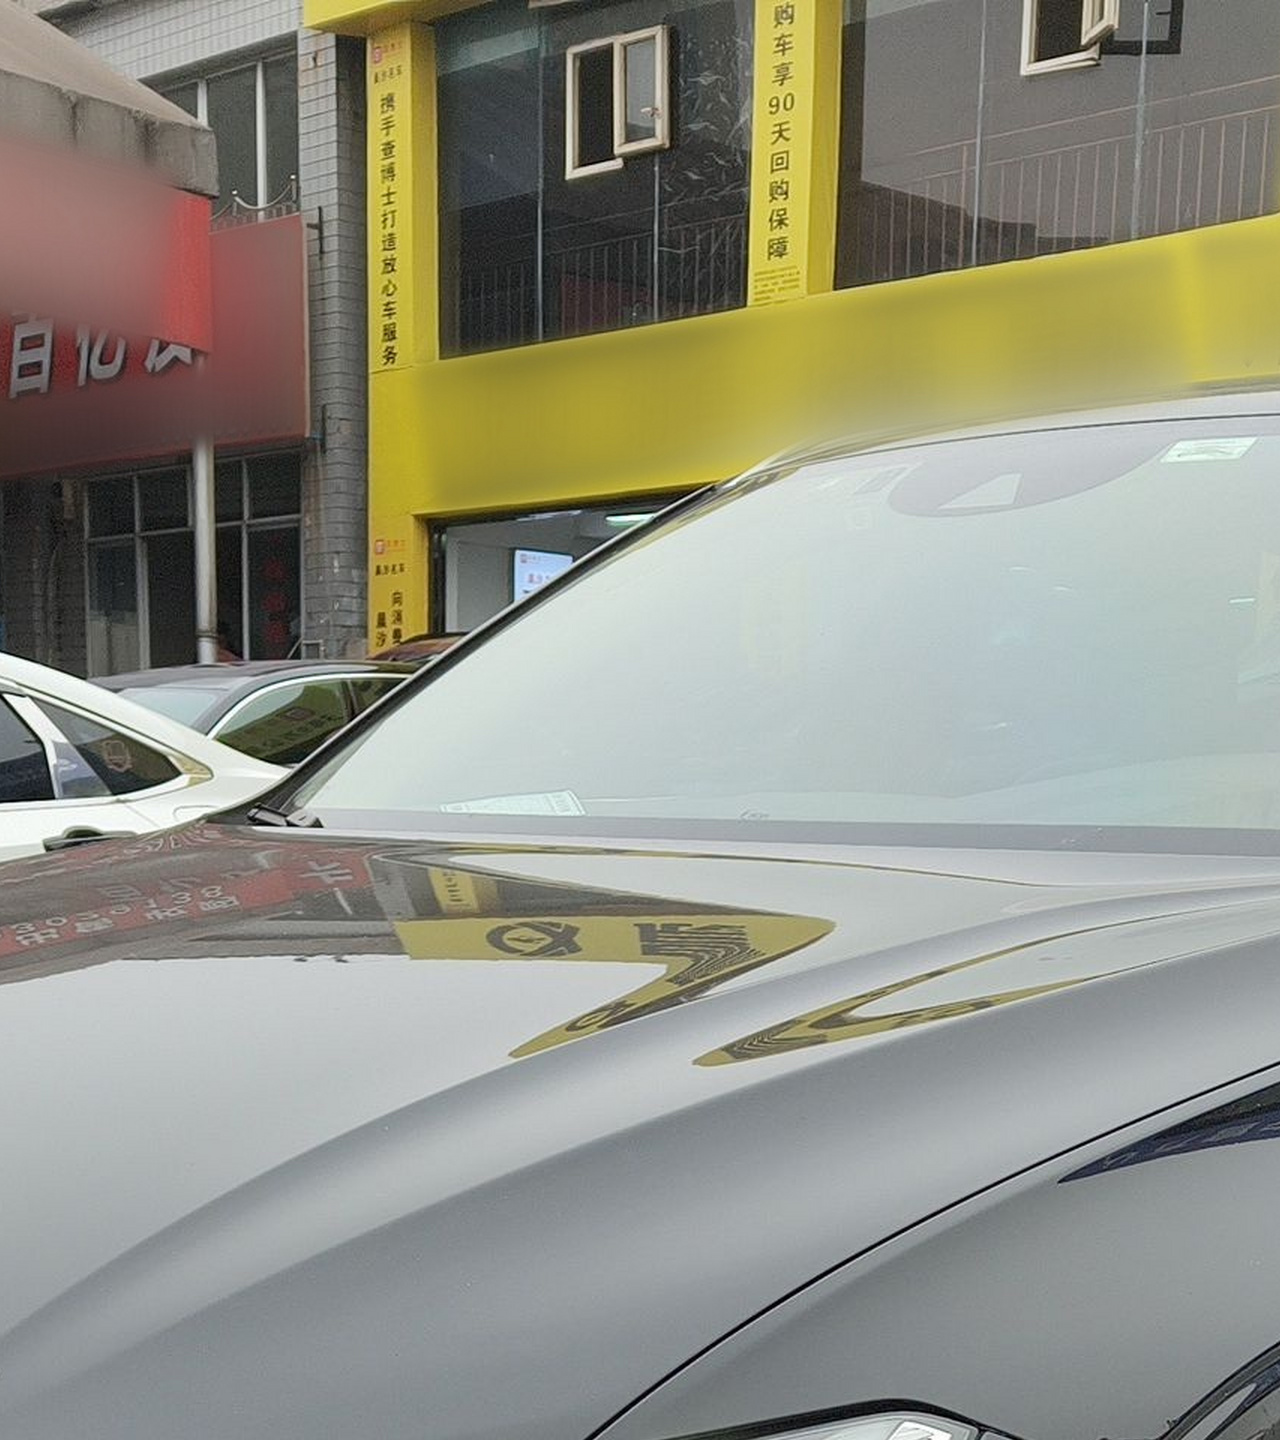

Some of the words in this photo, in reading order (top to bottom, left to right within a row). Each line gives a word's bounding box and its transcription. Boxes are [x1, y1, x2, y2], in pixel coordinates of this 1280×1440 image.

[767, 4, 795, 262] 购车享90天回购保障
